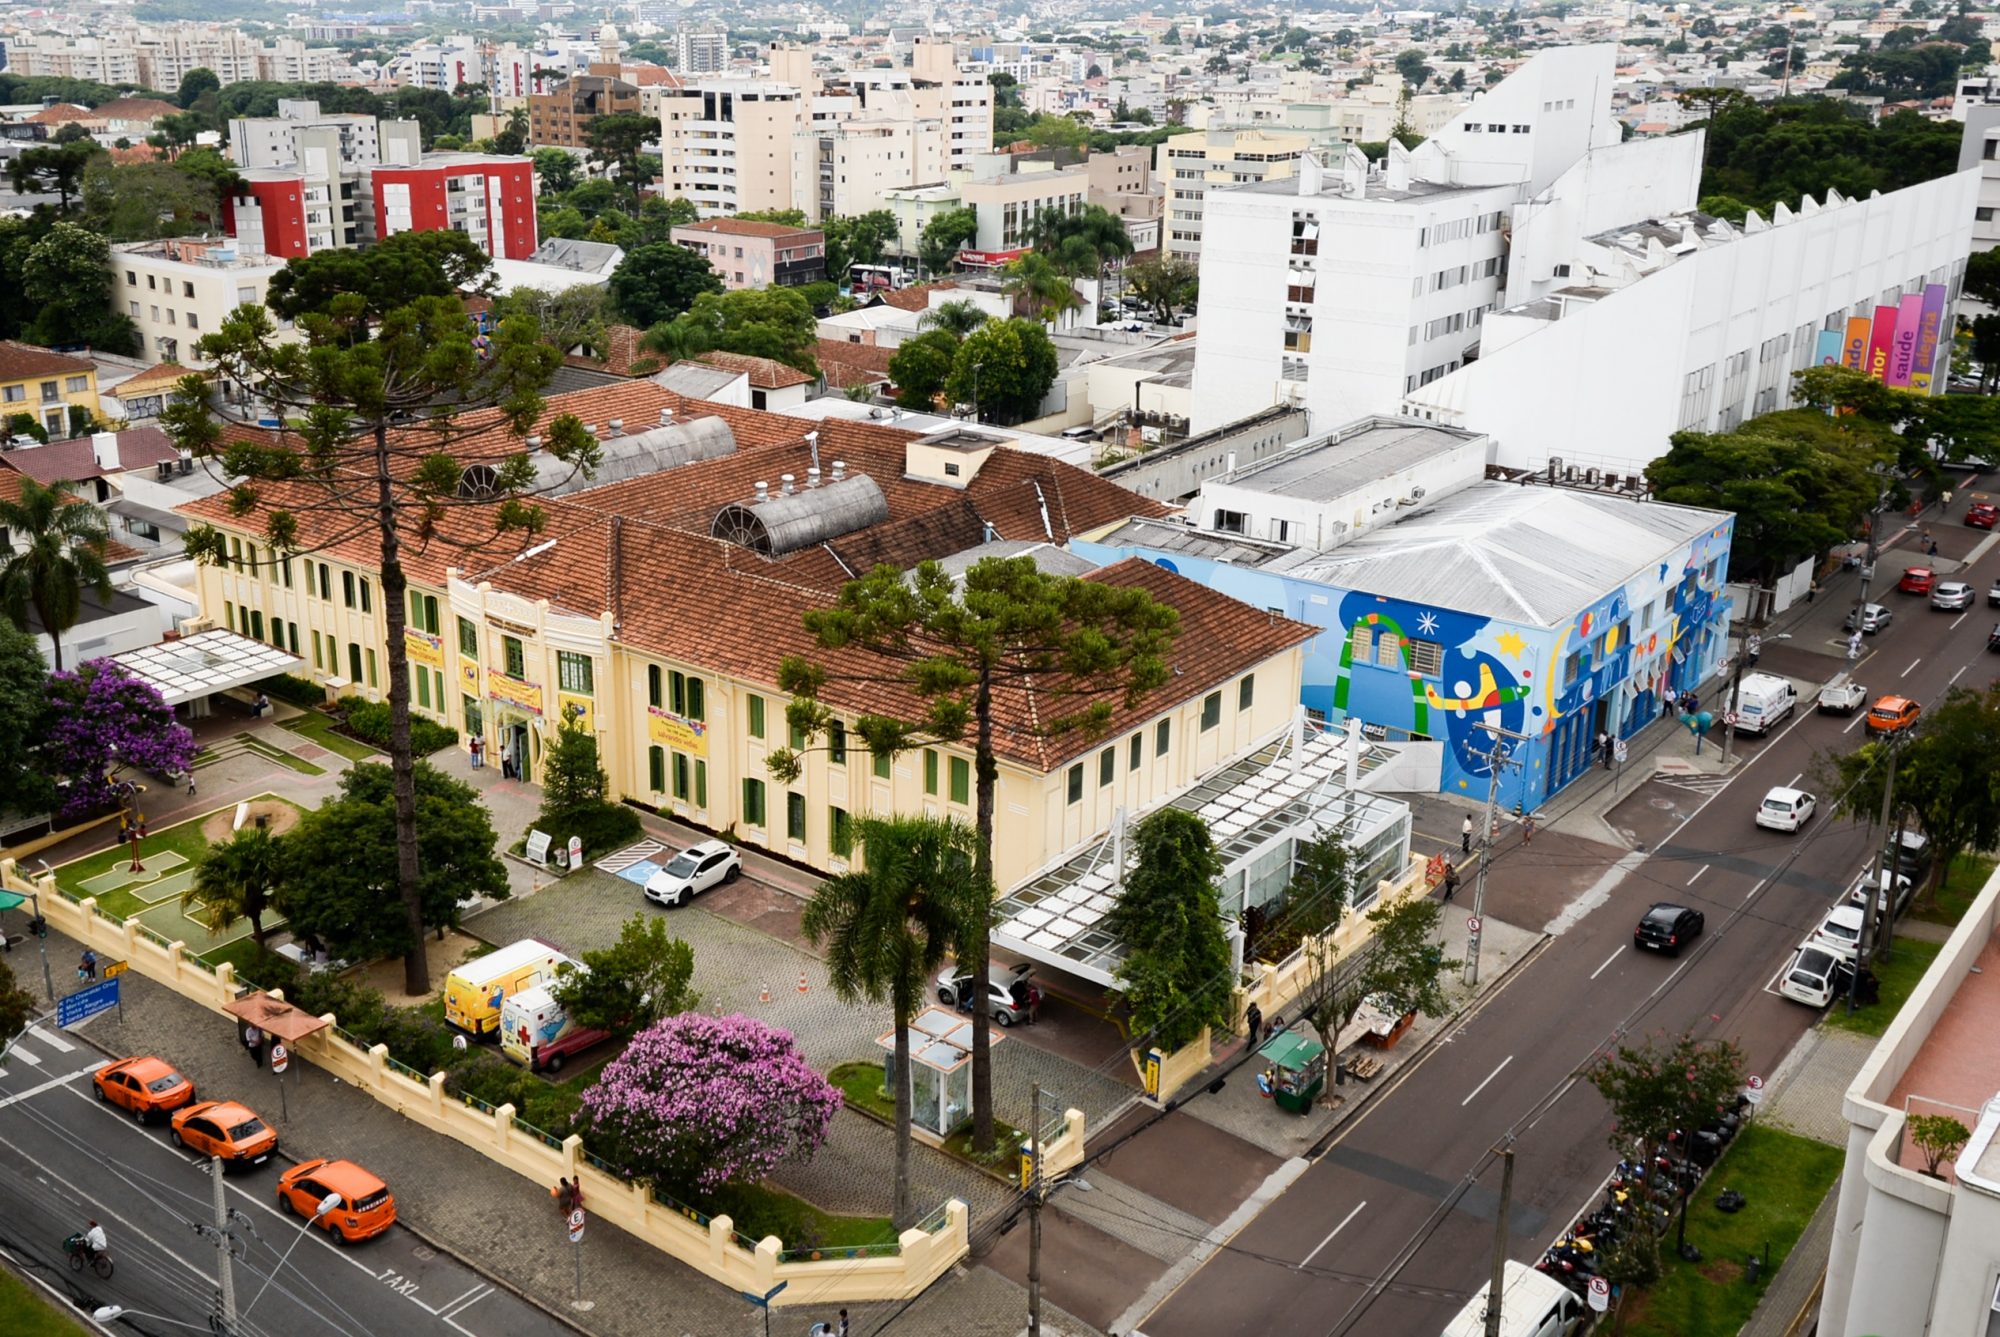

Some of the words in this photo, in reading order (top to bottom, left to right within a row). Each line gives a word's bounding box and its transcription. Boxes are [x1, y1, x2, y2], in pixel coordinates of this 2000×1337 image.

[1847, 338, 1864, 369] ado
[1915, 311, 1937, 368] alegria
[1871, 347, 1887, 379] mor
[1896, 331, 1914, 380] saúde
[275, 1047, 282, 1056] E
[192, 1157, 213, 1177] TAX
[573, 1212, 580, 1223] E
[377, 1268, 420, 1297] TAXI
